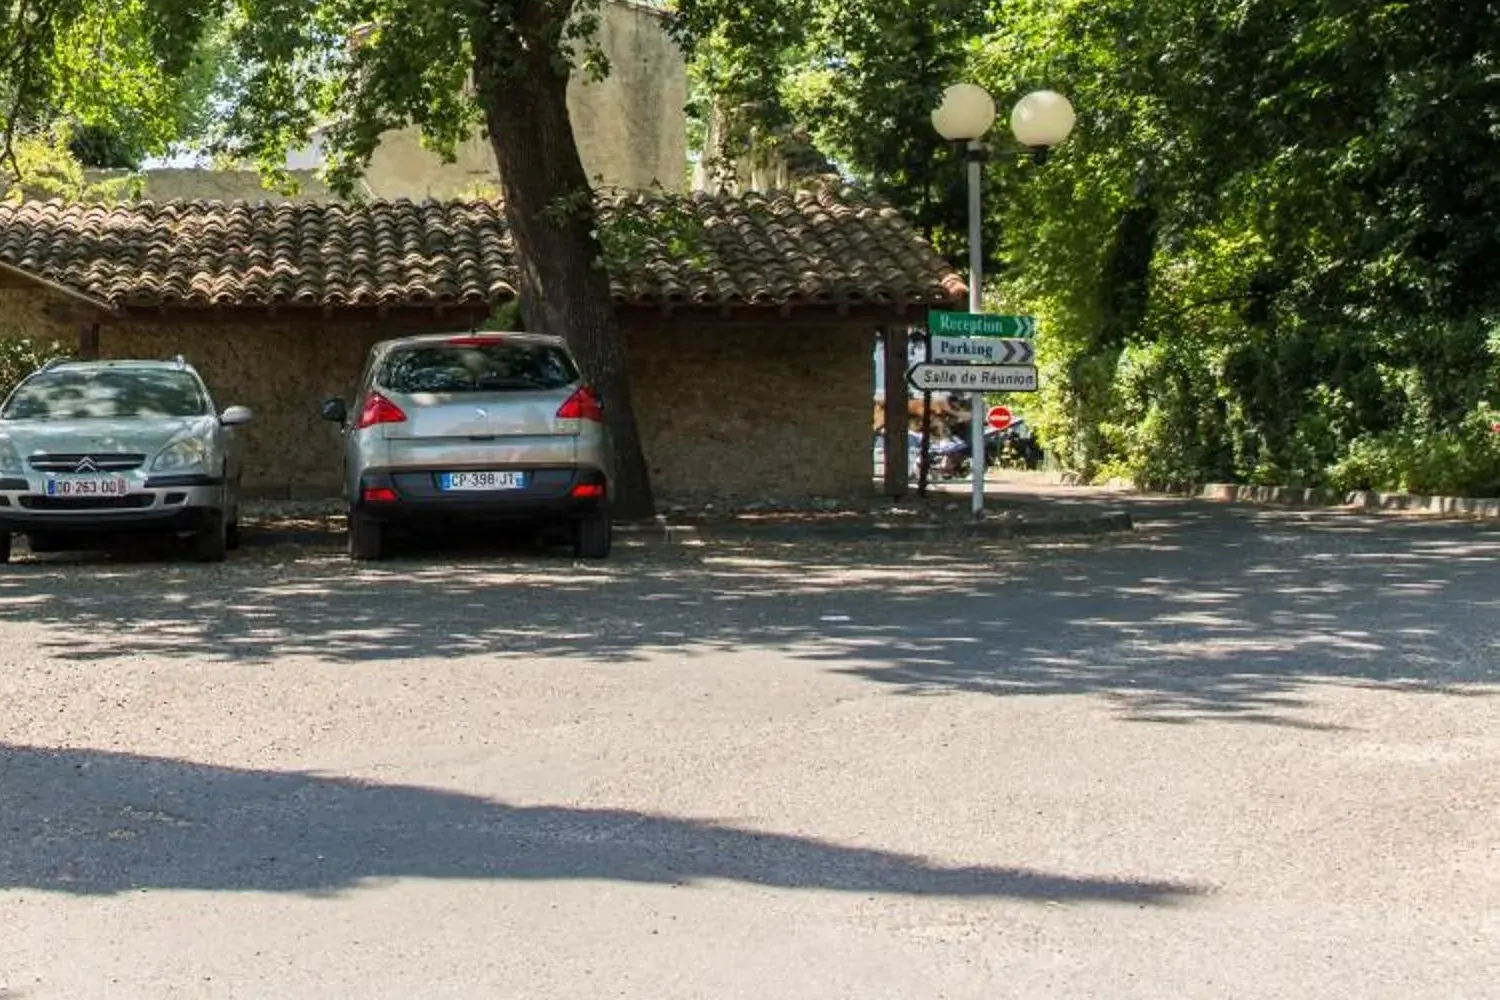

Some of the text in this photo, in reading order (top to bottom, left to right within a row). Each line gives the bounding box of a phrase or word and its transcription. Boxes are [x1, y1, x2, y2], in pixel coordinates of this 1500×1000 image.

[941, 341, 993, 359] Parking
[923, 369, 1034, 386] Salle de Réunion
